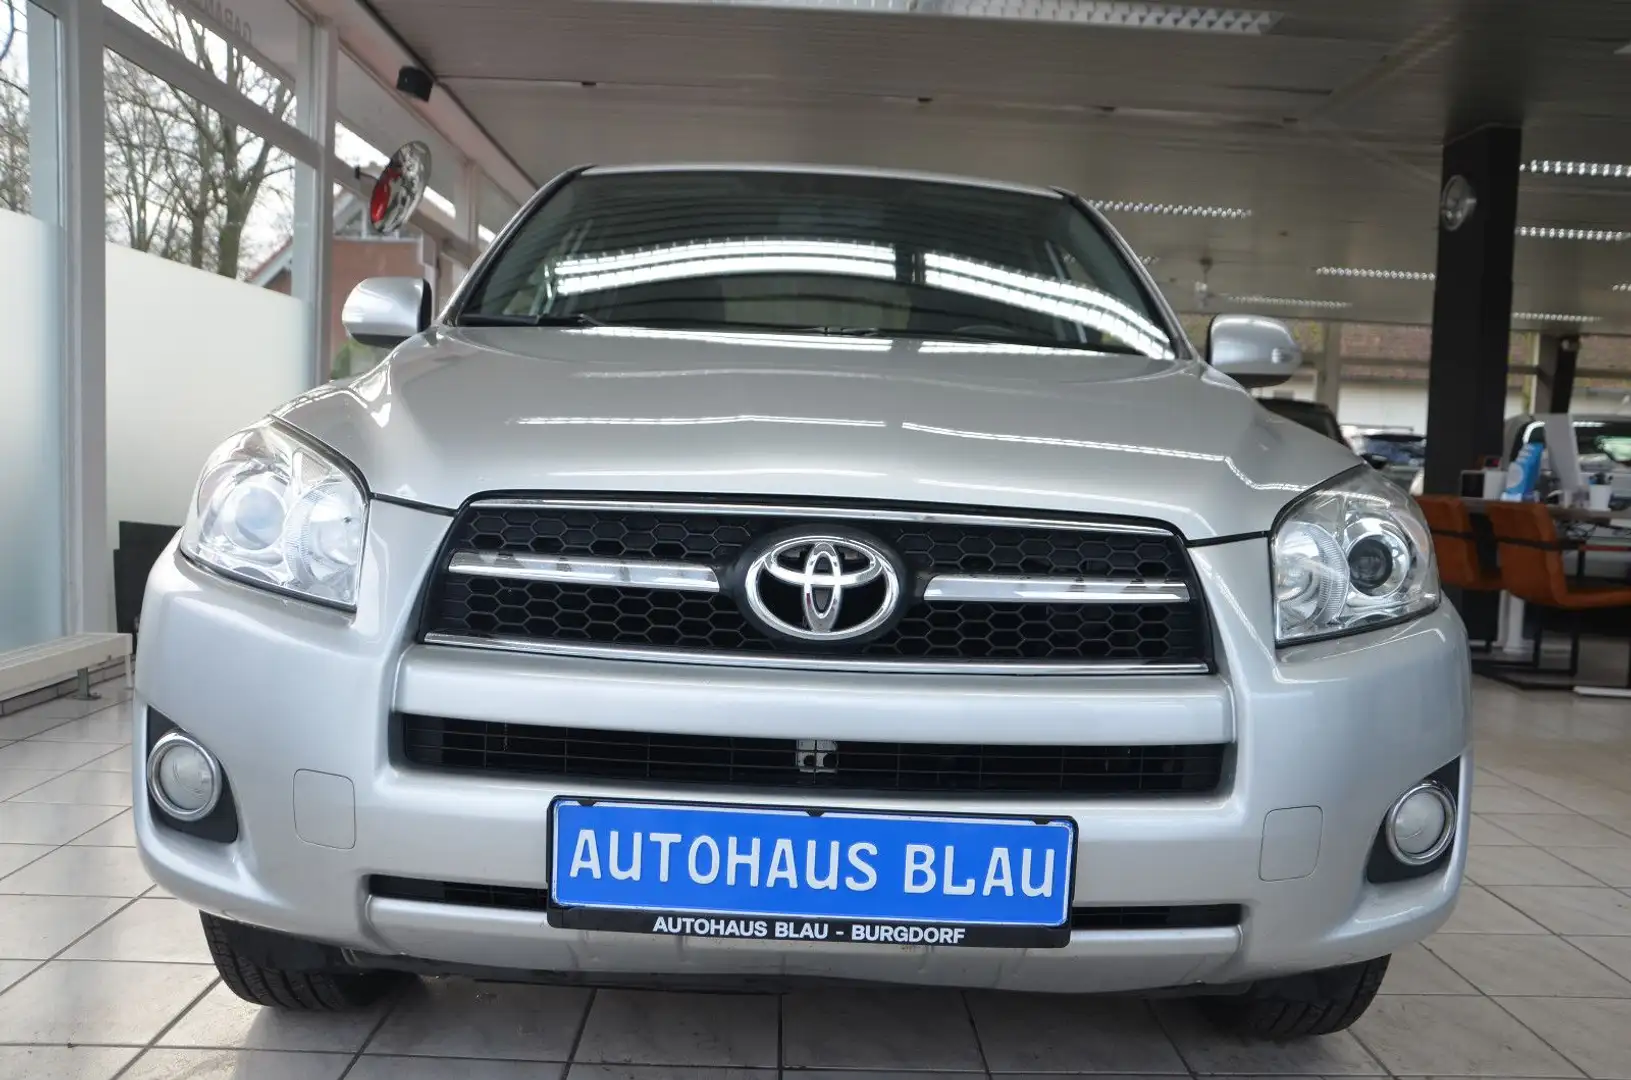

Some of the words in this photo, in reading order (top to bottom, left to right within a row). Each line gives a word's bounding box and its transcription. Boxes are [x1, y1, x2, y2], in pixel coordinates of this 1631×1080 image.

[569, 829, 879, 892] AUTOHAUS
[904, 843, 1055, 898] BLAU
[652, 915, 768, 937] AUTOHAUS
[774, 921, 829, 939] BLAU
[851, 924, 966, 944] BURGDORF
